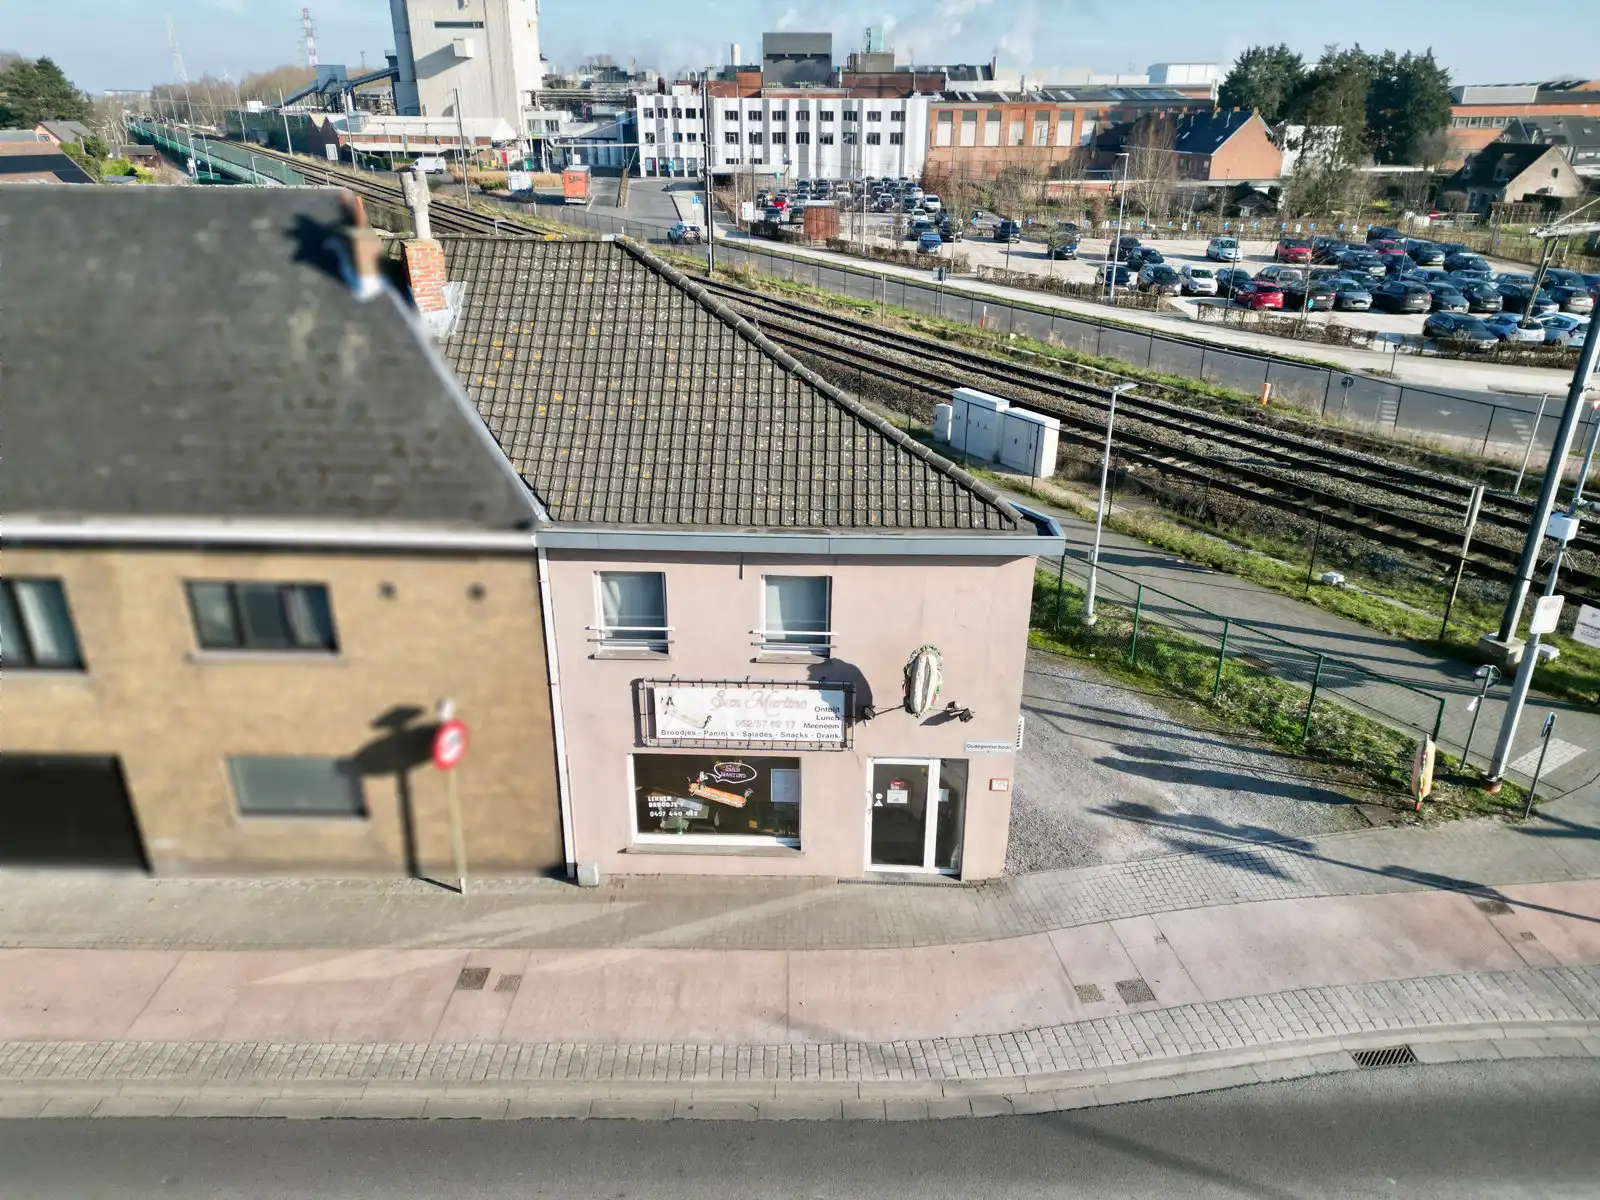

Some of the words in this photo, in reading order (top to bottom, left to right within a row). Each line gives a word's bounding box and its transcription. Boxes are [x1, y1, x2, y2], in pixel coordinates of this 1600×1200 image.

[814, 705, 840, 714] Ontbijt
[661, 729, 696, 737] Broodjes
[780, 731, 809, 739] Snacks
[725, 764, 741, 772] SAN
